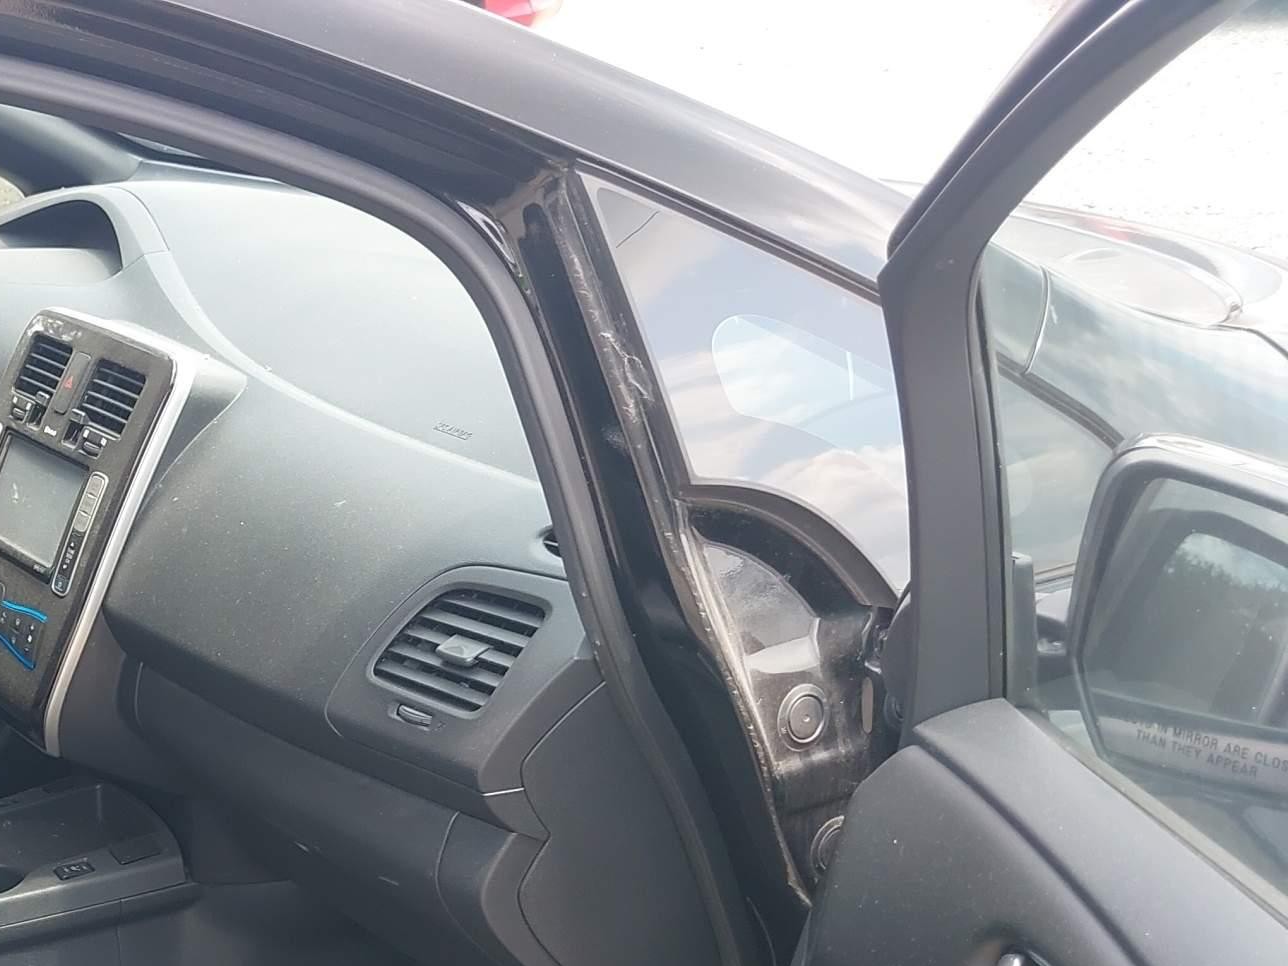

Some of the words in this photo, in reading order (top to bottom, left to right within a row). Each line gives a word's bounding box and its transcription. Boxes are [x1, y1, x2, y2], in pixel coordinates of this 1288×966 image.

[1135, 729, 1166, 750] THAN
[1171, 740, 1202, 761] THEY
[1206, 753, 1259, 777] APPEAR
[1172, 727, 1219, 751] MIRROR
[1223, 742, 1250, 760] ARE
